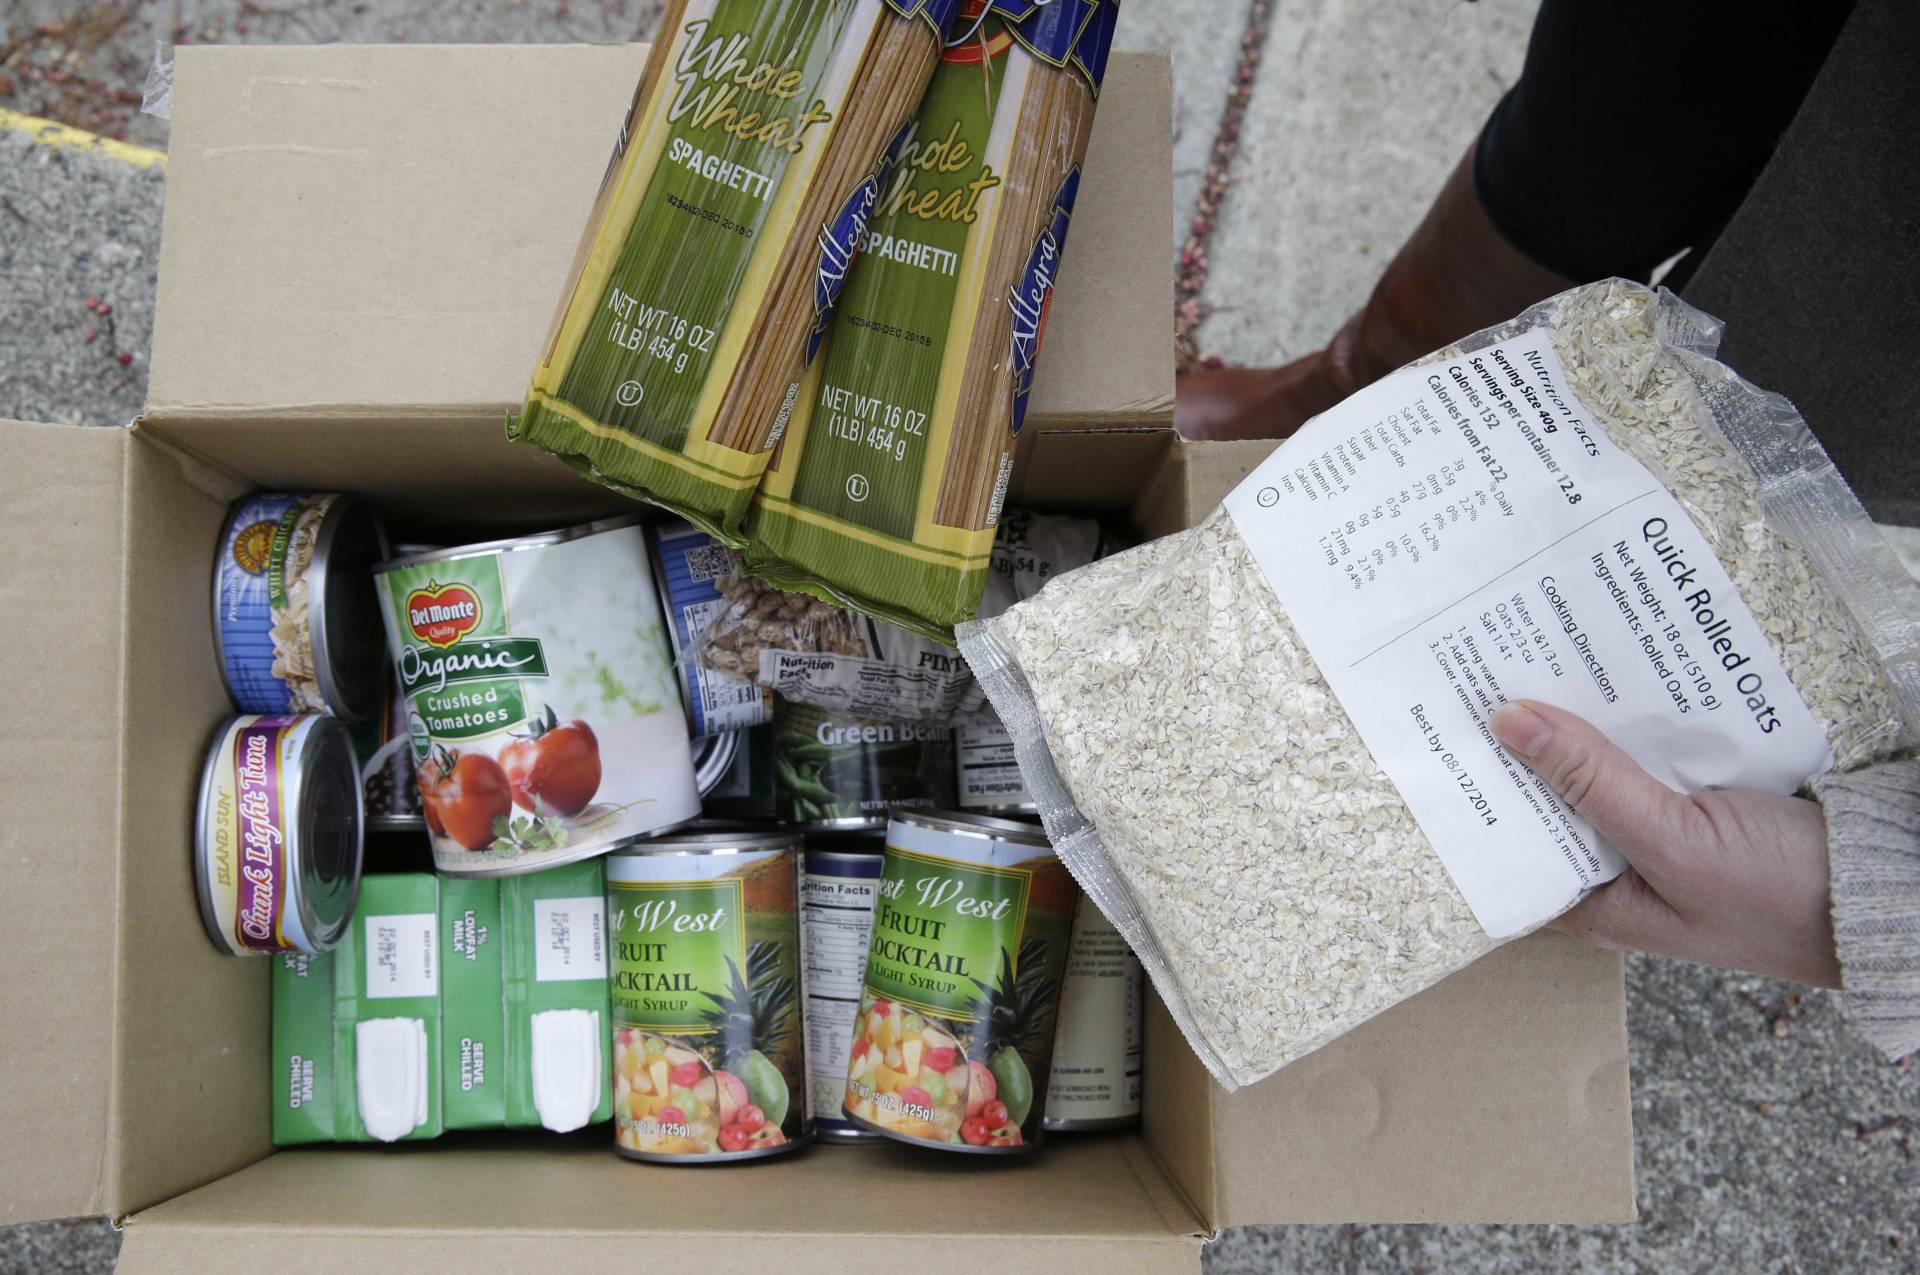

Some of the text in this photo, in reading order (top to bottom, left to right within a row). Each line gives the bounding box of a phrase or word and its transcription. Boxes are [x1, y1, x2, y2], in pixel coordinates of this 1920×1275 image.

[677, 18, 807, 98] Whole
[668, 72, 832, 153] Wheat
[669, 137, 775, 201] SPAGHETTI
[896, 120, 973, 173] hole
[818, 185, 878, 307] Allegra
[857, 231, 958, 276] SPAGHETTI
[608, 288, 715, 352] NET WT 16 OZ
[1007, 238, 1056, 369] Allegra
[608, 319, 689, 374] (1LB) 454 g
[822, 384, 927, 436] NET WT 16 OZ
[1449, 365, 1500, 429] Calories 152
[1490, 349, 1558, 433] Serving Size 40g
[1524, 350, 1600, 456] Nutrition Facts
[829, 411, 907, 461] (1LB) 454 g
[1414, 398, 1488, 506] Total Fat 3g 4%
[1427, 375, 1507, 483] Calories from Fat 22
[1469, 357, 1582, 504] Servings per container 12.8
[1359, 429, 1439, 552] Fiber 4g 16.2%
[1374, 422, 1446, 530] Total Carbs 27g 9%
[1388, 414, 1460, 522] Cholest 0mg 0%
[1401, 407, 1479, 521] Sat Fat 0.5g 2.2%
[1281, 474, 1339, 566] Iron 1.7mg
[1294, 467, 1363, 590] Calcium 21mg 9.4%
[1308, 459, 1377, 581] Vitamin 0g 2.1%
[1320, 451, 1384, 565] Vitamin 0g 0%
[1334, 445, 1398, 557] Protein 0%
[1347, 436, 1421, 563] Sugar 0.5g 10.5%
[1494, 492, 1514, 517] Daily
[270, 556, 282, 598] WHITE
[1613, 540, 1634, 568] Net
[1663, 623, 1681, 641] 18
[1674, 643, 1690, 662] oz
[411, 601, 475, 626] Del Monte
[429, 626, 455, 638] Quality
[1480, 611, 1509, 655] Salt 1/4
[1495, 603, 1535, 664] Oats 2/3 cu
[1511, 593, 1564, 677] Water 1&1/3 cu
[1541, 576, 1619, 703] Cooking Directions
[1591, 552, 1691, 713] Ingredients: Rolled Oats
[1642, 517, 1781, 734] Quick Rolled Oats
[401, 642, 535, 693] Organic
[779, 667, 811, 679] Facts
[780, 655, 834, 670] Nutrition
[1449, 643, 1465, 666] Add
[1462, 665, 1478, 688] oats
[1476, 686, 1492, 710] and
[1463, 635, 1500, 693] Bring water
[426, 707, 508, 731] Tomatoes
[428, 687, 497, 712] Crushed
[240, 734, 267, 790] Tuna
[817, 721, 895, 745] Green
[1436, 651, 1455, 684] Cover,
[1455, 683, 1480, 722] remove
[1477, 721, 1495, 746] from
[1492, 744, 1512, 769] heat
[1509, 769, 1526, 788] and
[1522, 788, 1544, 815] serve
[1540, 815, 1552, 826] in
[1549, 826, 1565, 844] 2-3
[1410, 703, 1498, 826] Best by 08/12/2014
[217, 791, 233, 887] ISLAND SUN
[240, 791, 282, 867] Light
[1533, 778, 1601, 876] stirring occasionally.
[241, 866, 273, 940] Chunk
[633, 900, 726, 932] West
[807, 882, 870, 895] rition Facts
[880, 876, 1012, 920] est West
[453, 920, 463, 952] MILK
[465, 910, 476, 961] LOWFAT
[477, 926, 487, 945] 1%
[880, 904, 946, 941] FRUIT
[614, 971, 698, 991] CKTAIL
[643, 997, 688, 1011] SYRUP
[875, 962, 956, 994] LIGHT SYRUP
[290, 1055, 301, 1108] CHILLED
[303, 1059, 314, 1103] SERVE
[461, 1038, 472, 1091] CHILLED
[473, 1042, 484, 1084] SERVE
[657, 1123, 690, 1137] (425g)
[900, 1102, 934, 1121] (425g)
